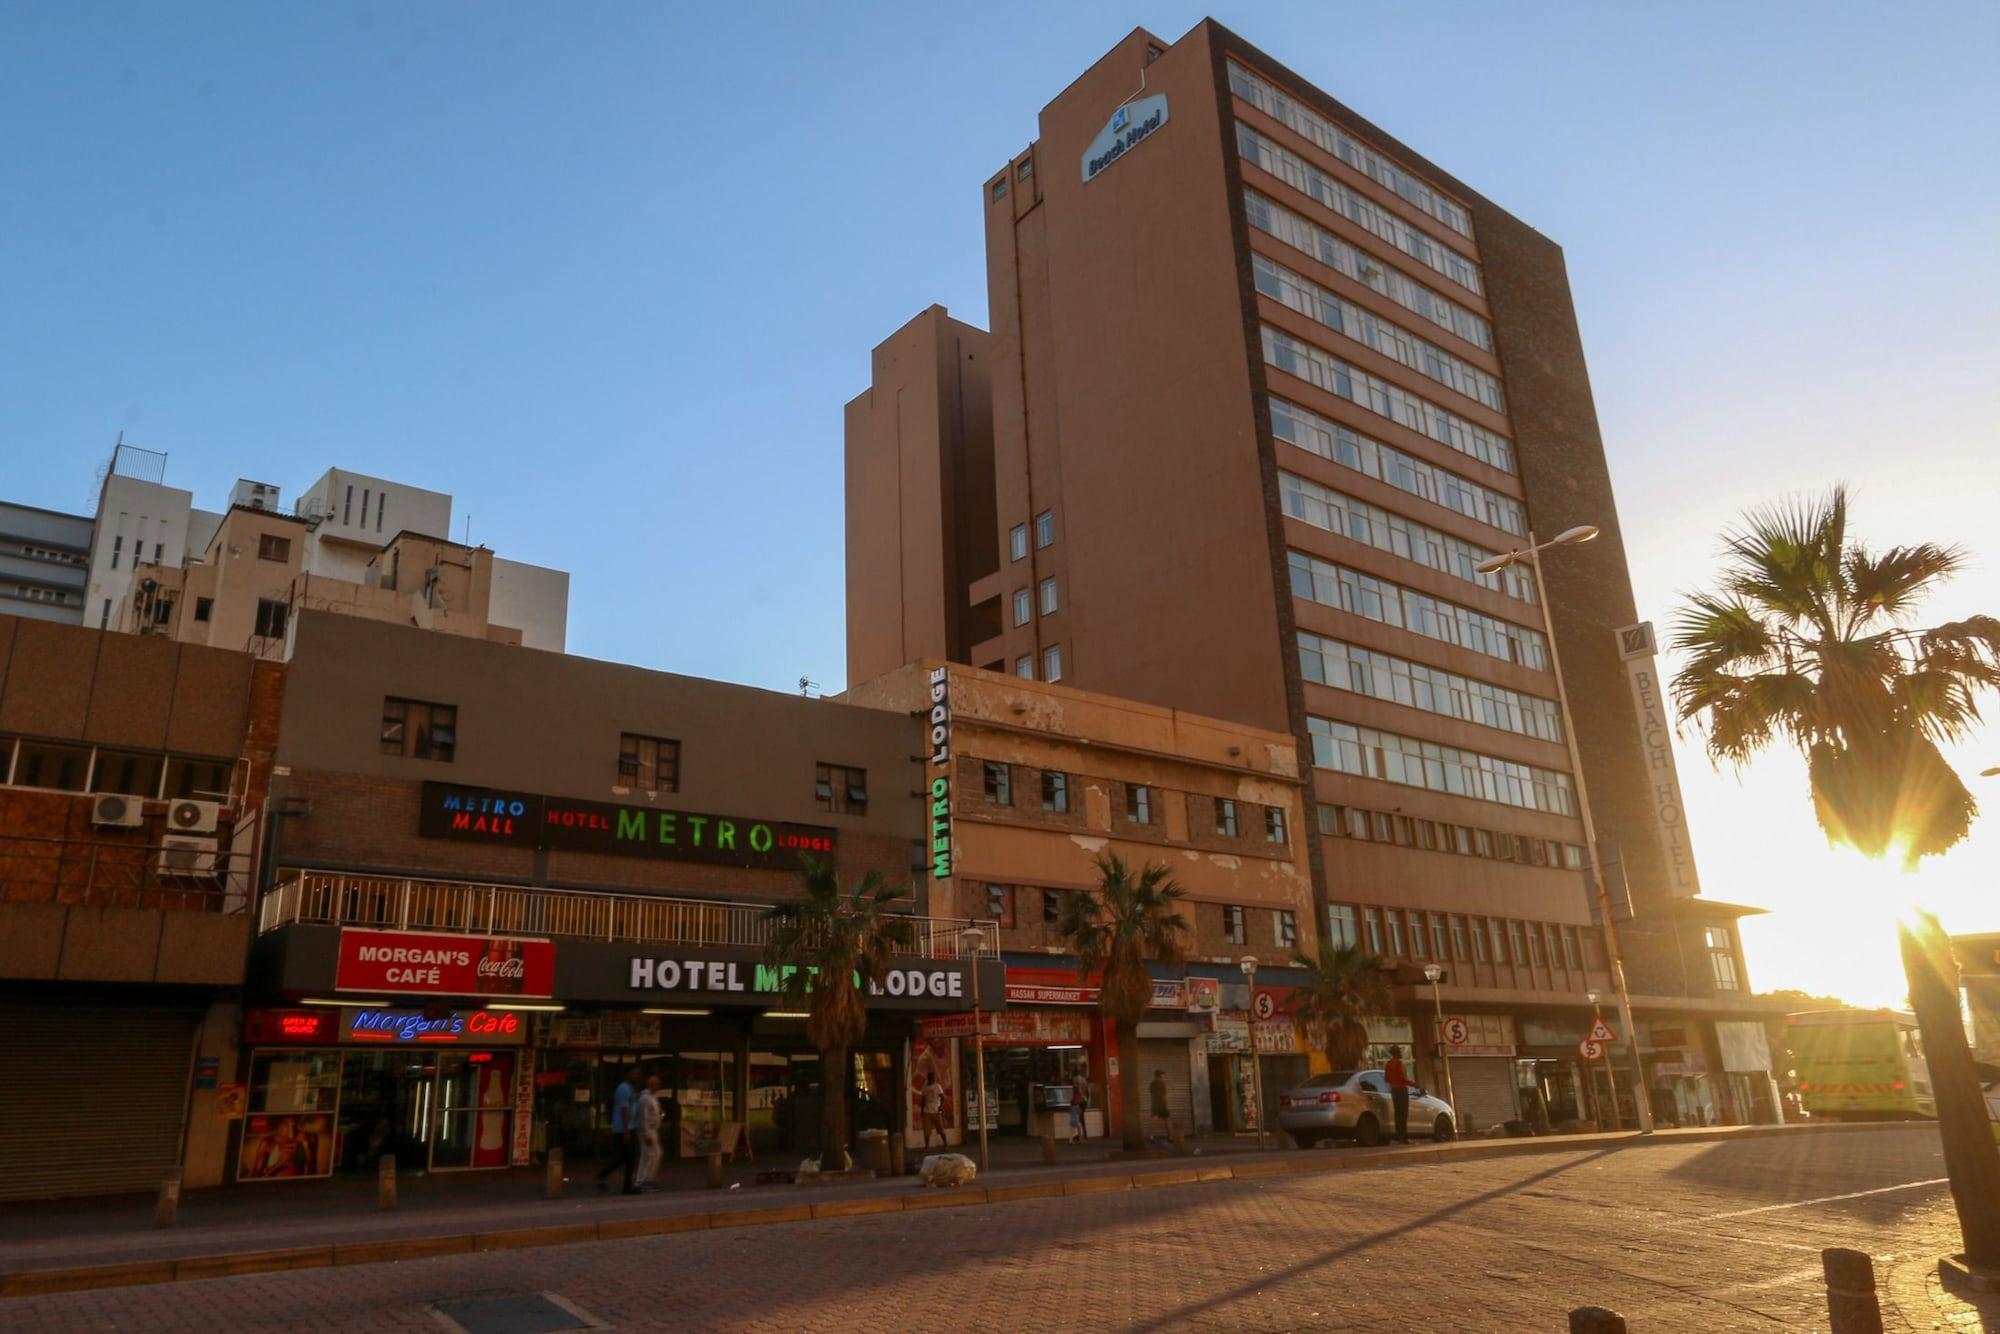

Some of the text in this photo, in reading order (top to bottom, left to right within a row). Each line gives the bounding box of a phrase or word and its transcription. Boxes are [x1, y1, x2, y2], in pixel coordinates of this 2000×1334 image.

[1126, 109, 1161, 148] Hotel
[930, 667, 950, 877] METRO LODGE
[1635, 671, 1690, 888] BEACH HOTEL
[443, 794, 525, 816] METRO
[452, 813, 514, 835] MALL
[547, 807, 833, 853] HOTEL METRO LODGE
[358, 946, 524, 978] MORGAN'S Coca-Cola
[385, 966, 441, 985] CAFÉ
[630, 957, 745, 992] HOTEL
[868, 969, 963, 998] LODGE
[1010, 989, 1035, 1000] HASSAN
[1037, 990, 1081, 1001] SUPERMARKET
[282, 1017, 305, 1026] OPEN
[284, 1025, 315, 1034] HOURS
[352, 1009, 518, 1040] Morgan's Cafe
